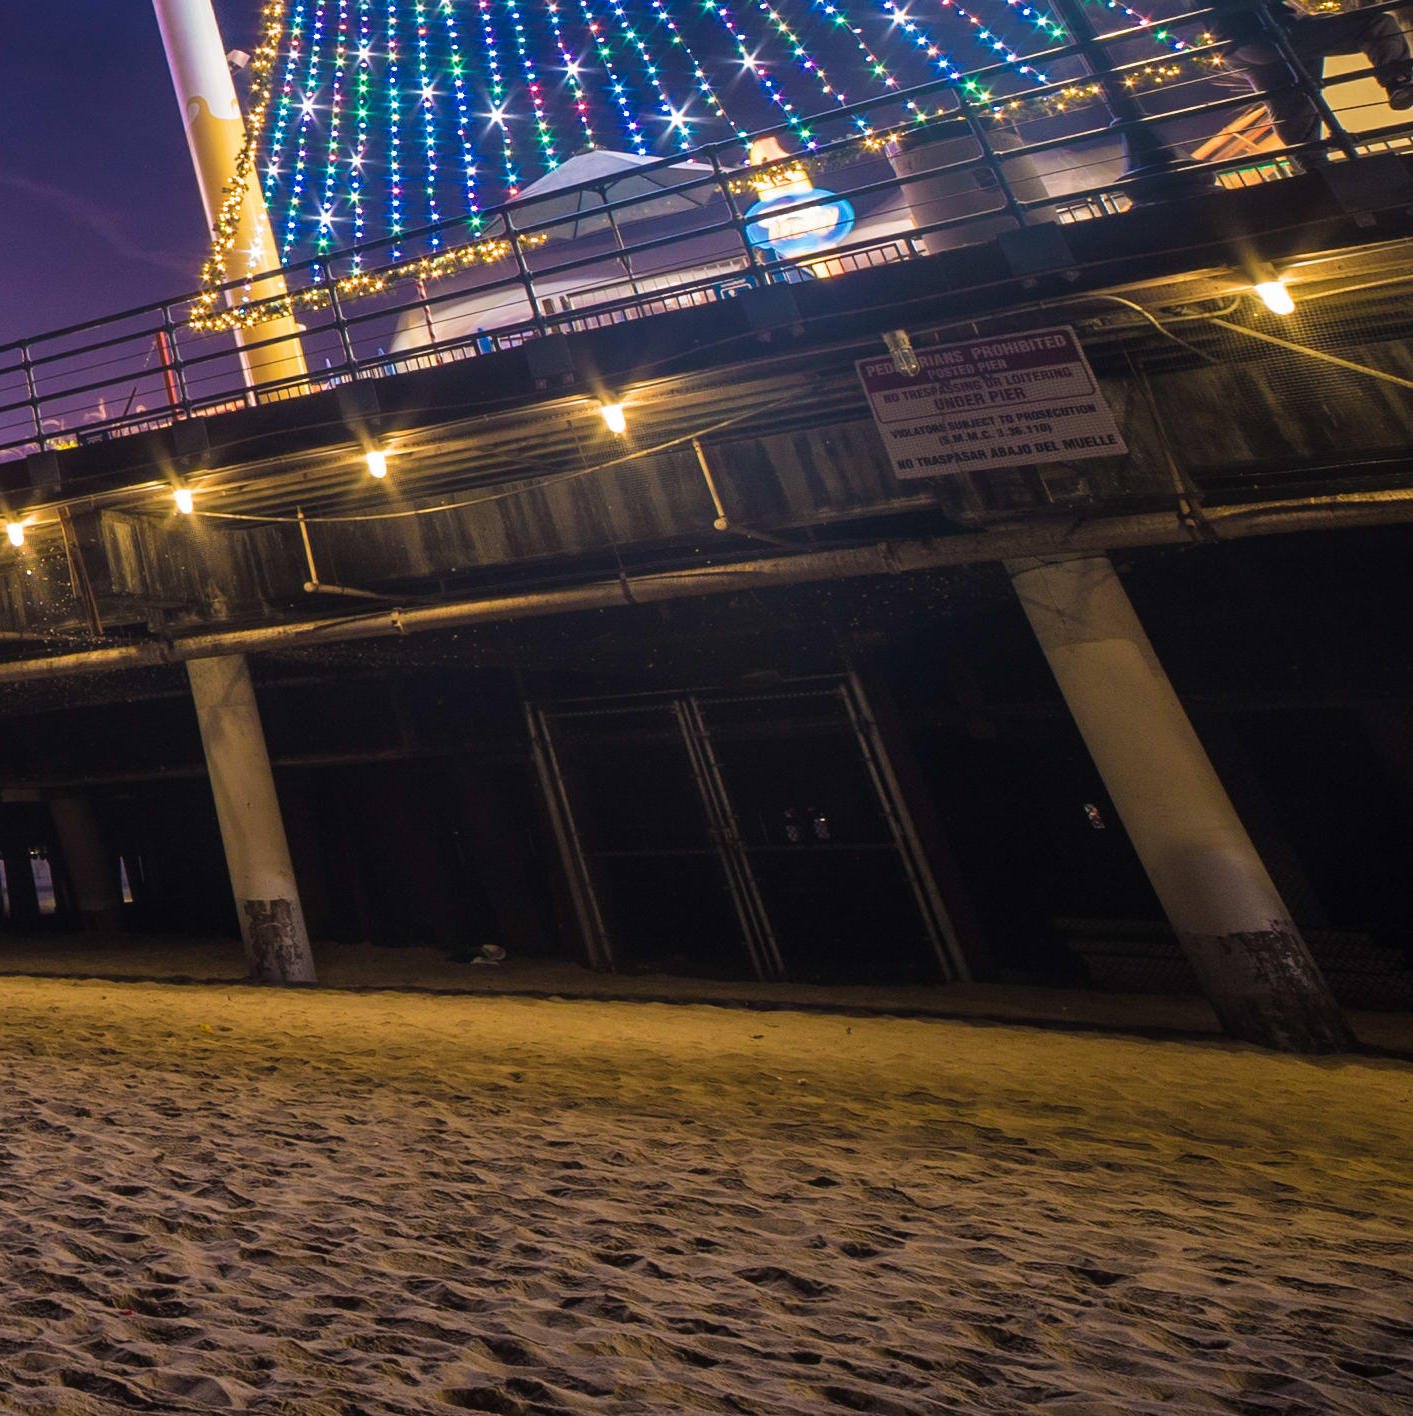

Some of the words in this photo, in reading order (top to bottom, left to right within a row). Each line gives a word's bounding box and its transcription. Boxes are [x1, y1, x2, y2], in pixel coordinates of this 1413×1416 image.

[865, 350, 964, 377] PEDRIANS
[972, 335, 1066, 360] PROHIBITED
[928, 364, 974, 380] POSTED
[976, 359, 1008, 373] PIER
[883, 393, 900, 403] NO
[901, 379, 982, 400] TRESPASSING
[985, 375, 1004, 388] OR
[1004, 366, 1073, 385] LOITERING
[934, 393, 986, 411] UNDER
[988, 388, 1027, 403] PIER
[890, 424, 947, 438] VIOLATORS
[948, 416, 996, 430] SUBJECT
[998, 414, 1014, 424] TO
[1016, 403, 1097, 422] PROSECUTION
[897, 458, 914, 470] NO
[916, 450, 987, 467] TRASPASAR
[991, 444, 1032, 458] ABAJO
[1034, 441, 1061, 452] DEL
[1062, 434, 1117, 450] MUELLE
